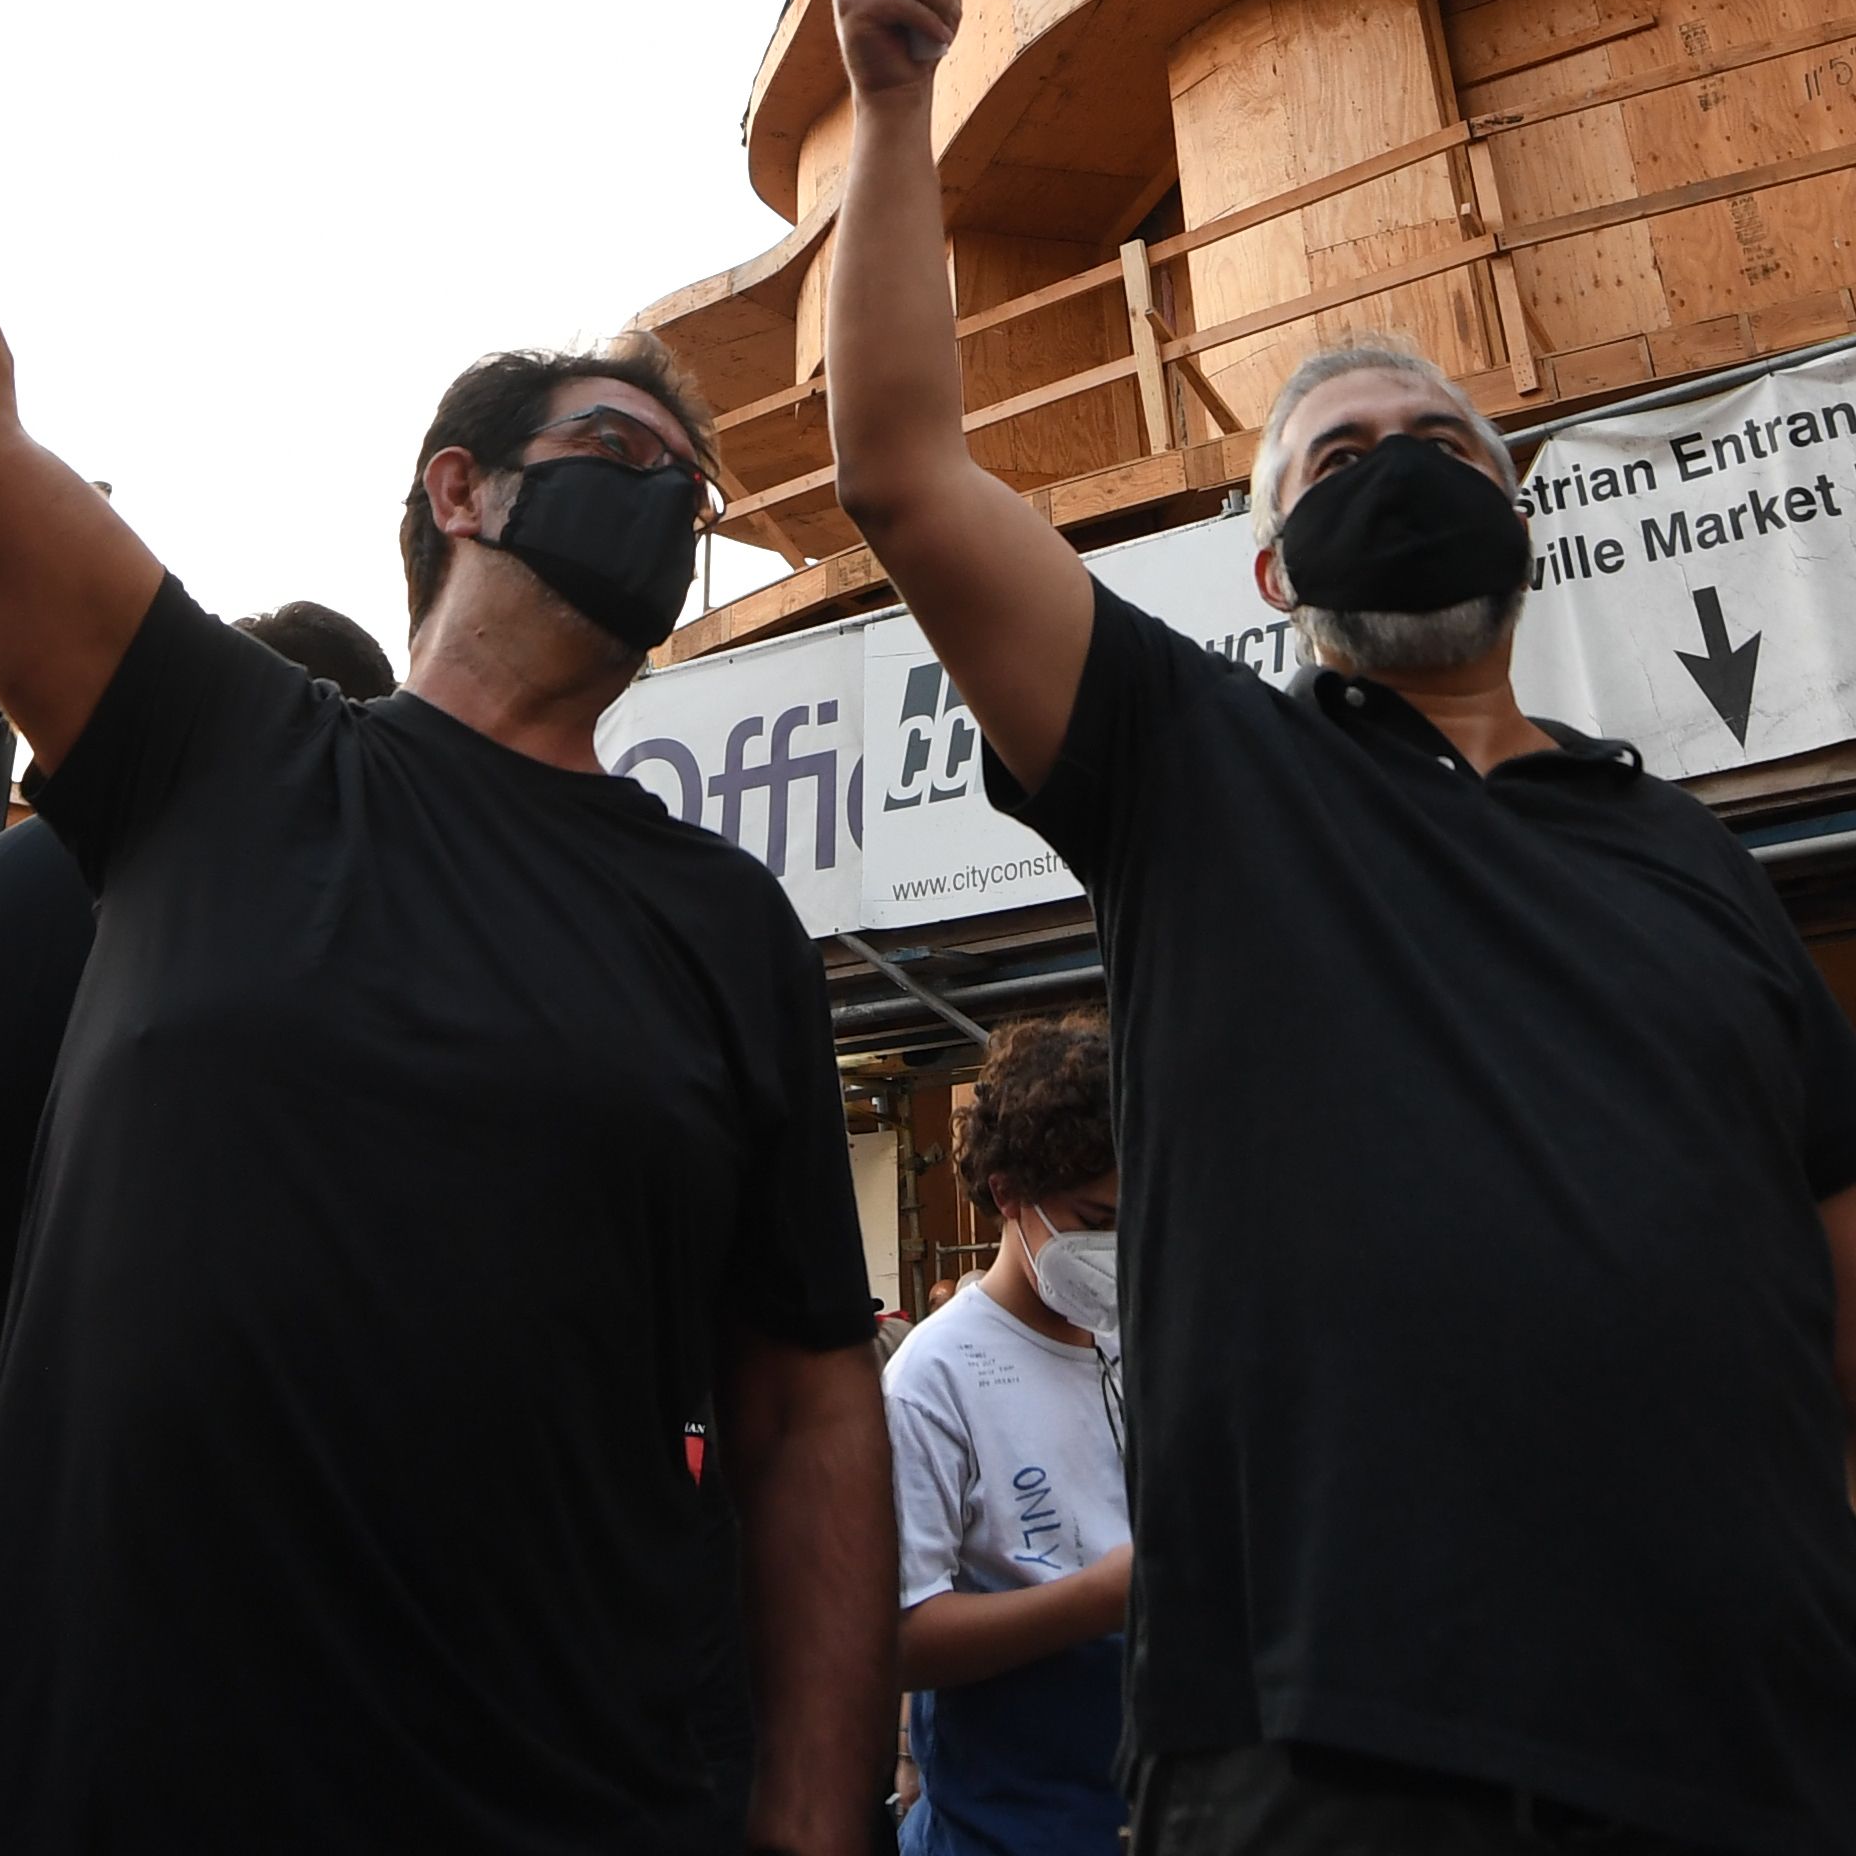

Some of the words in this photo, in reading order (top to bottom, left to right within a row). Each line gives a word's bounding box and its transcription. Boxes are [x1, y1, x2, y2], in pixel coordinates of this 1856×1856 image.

[1640, 473, 1843, 564] Market
[612, 698, 863, 879] Offi
[1012, 1466, 1062, 1570] ONLY
